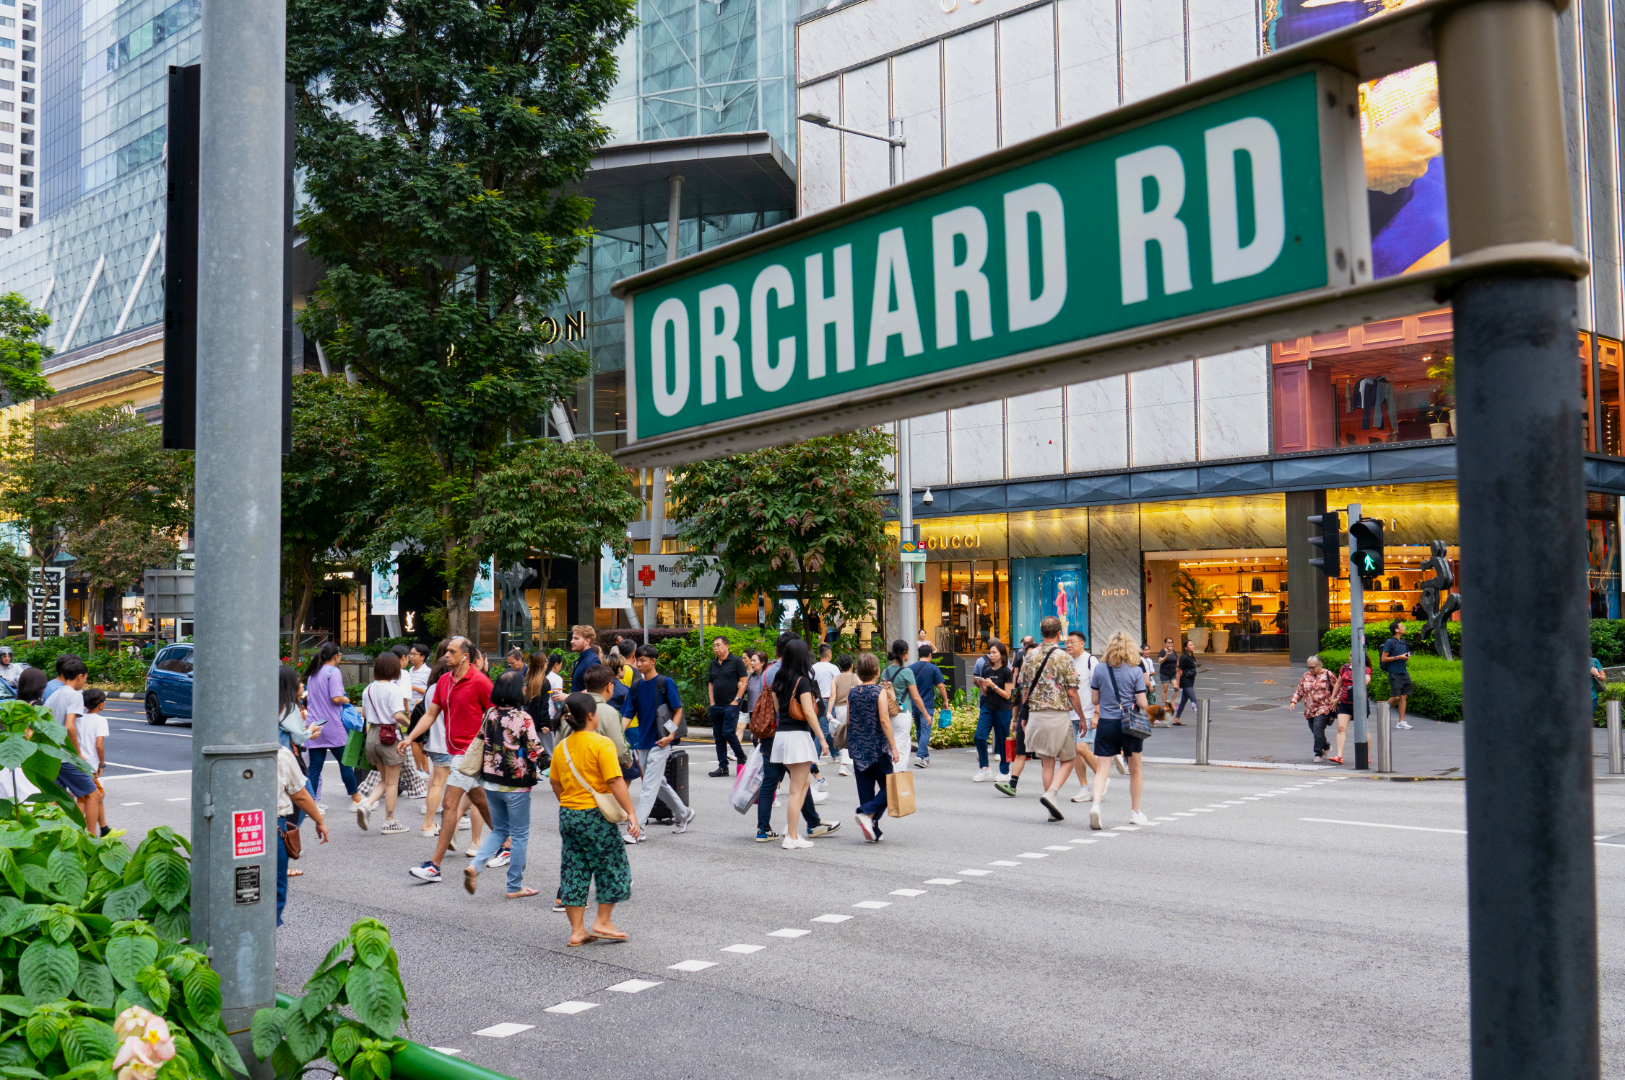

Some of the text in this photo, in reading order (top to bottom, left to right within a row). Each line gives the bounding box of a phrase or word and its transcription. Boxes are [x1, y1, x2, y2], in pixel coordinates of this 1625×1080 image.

[650, 117, 1285, 417] ORCHARD RD
[926, 533, 981, 550] GUCCI
[1586, 568, 1615, 591] CCI
[1100, 588, 1129, 597] GUCCI
[237, 824, 261, 833] DANGER
[238, 846, 261, 855] BAHAYA
